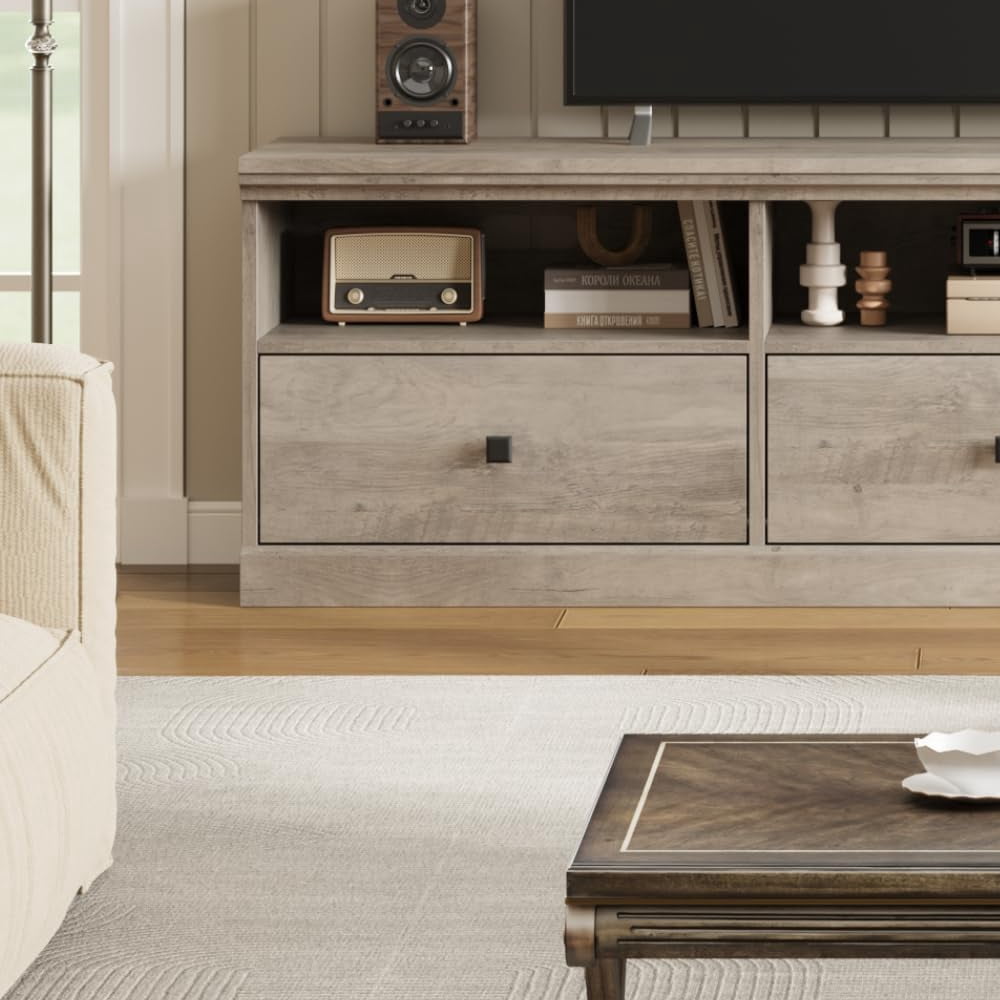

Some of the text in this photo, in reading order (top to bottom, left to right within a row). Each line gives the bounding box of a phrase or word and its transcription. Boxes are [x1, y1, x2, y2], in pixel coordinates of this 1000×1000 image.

[581, 274, 620, 286] КОРОЛИ
[622, 274, 661, 286] ОКЕАНА
[576, 315, 599, 327] КНИГА
